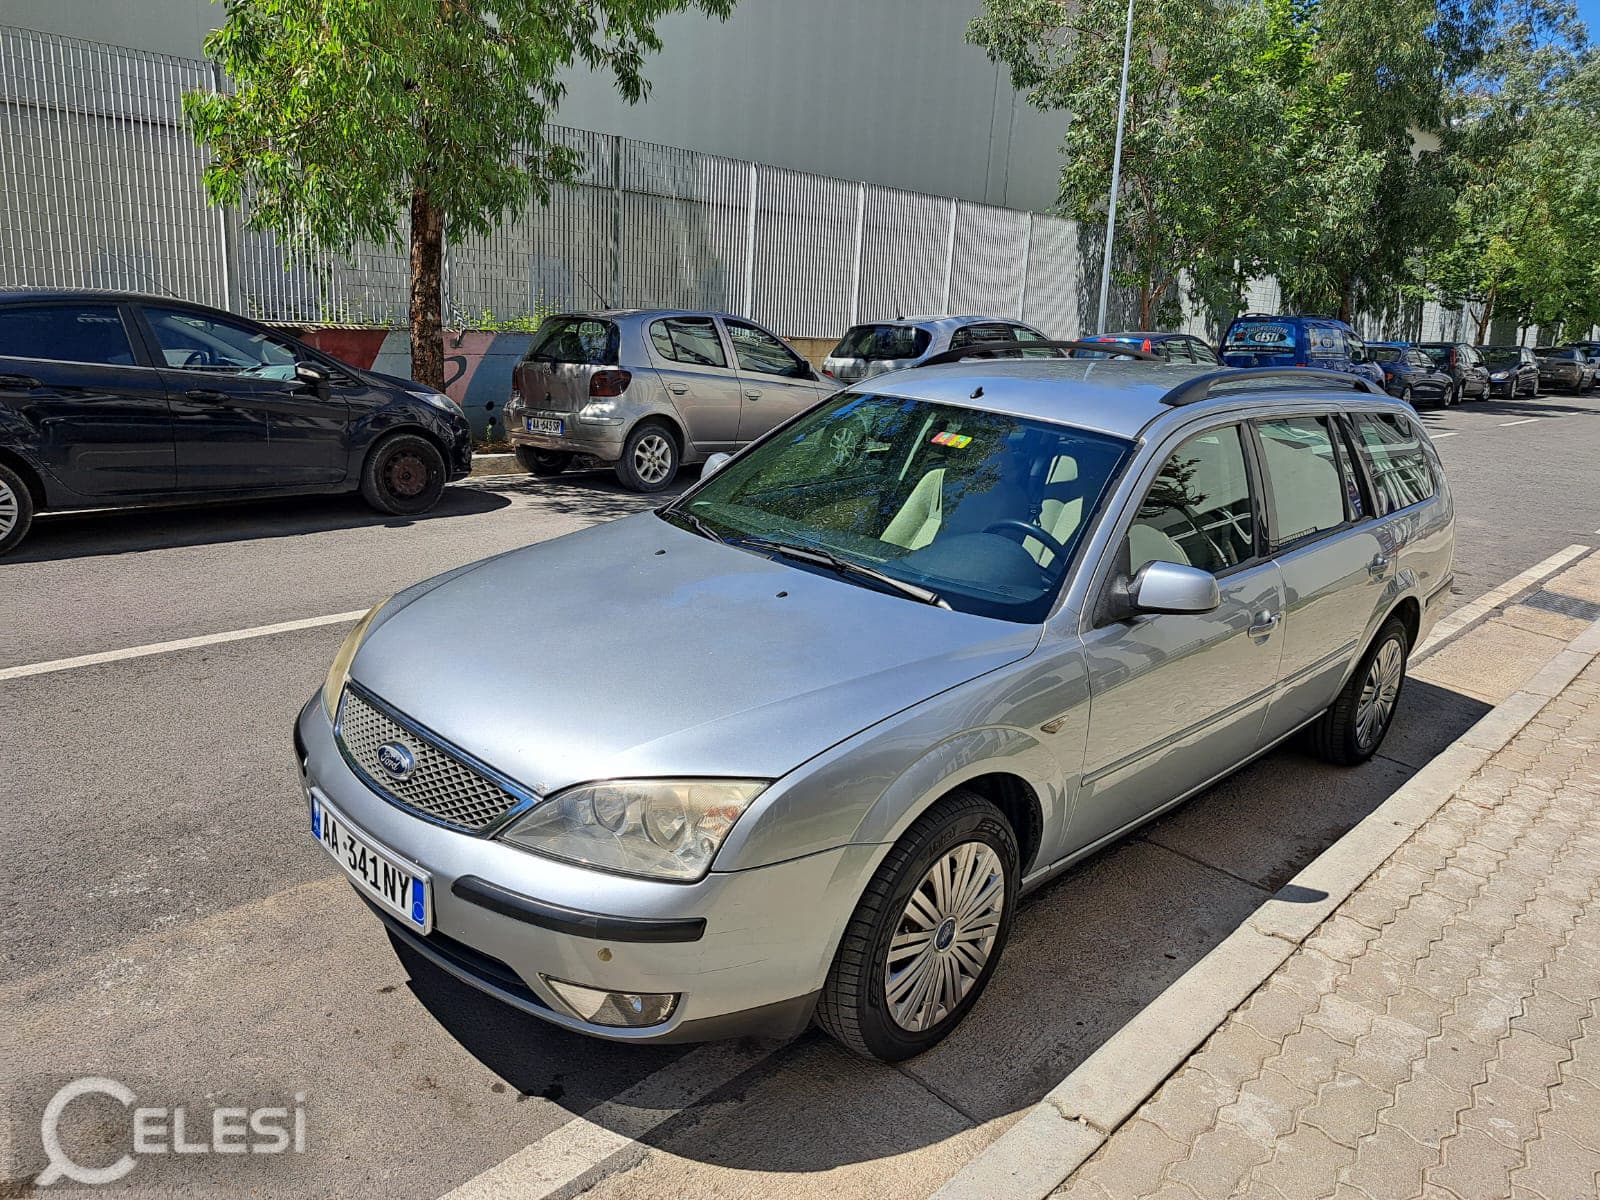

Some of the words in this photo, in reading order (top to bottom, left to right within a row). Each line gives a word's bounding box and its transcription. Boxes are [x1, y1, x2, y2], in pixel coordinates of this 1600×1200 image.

[1254, 332, 1280, 343] GESTI
[380, 750, 401, 771] Ford
[323, 811, 339, 855] AA
